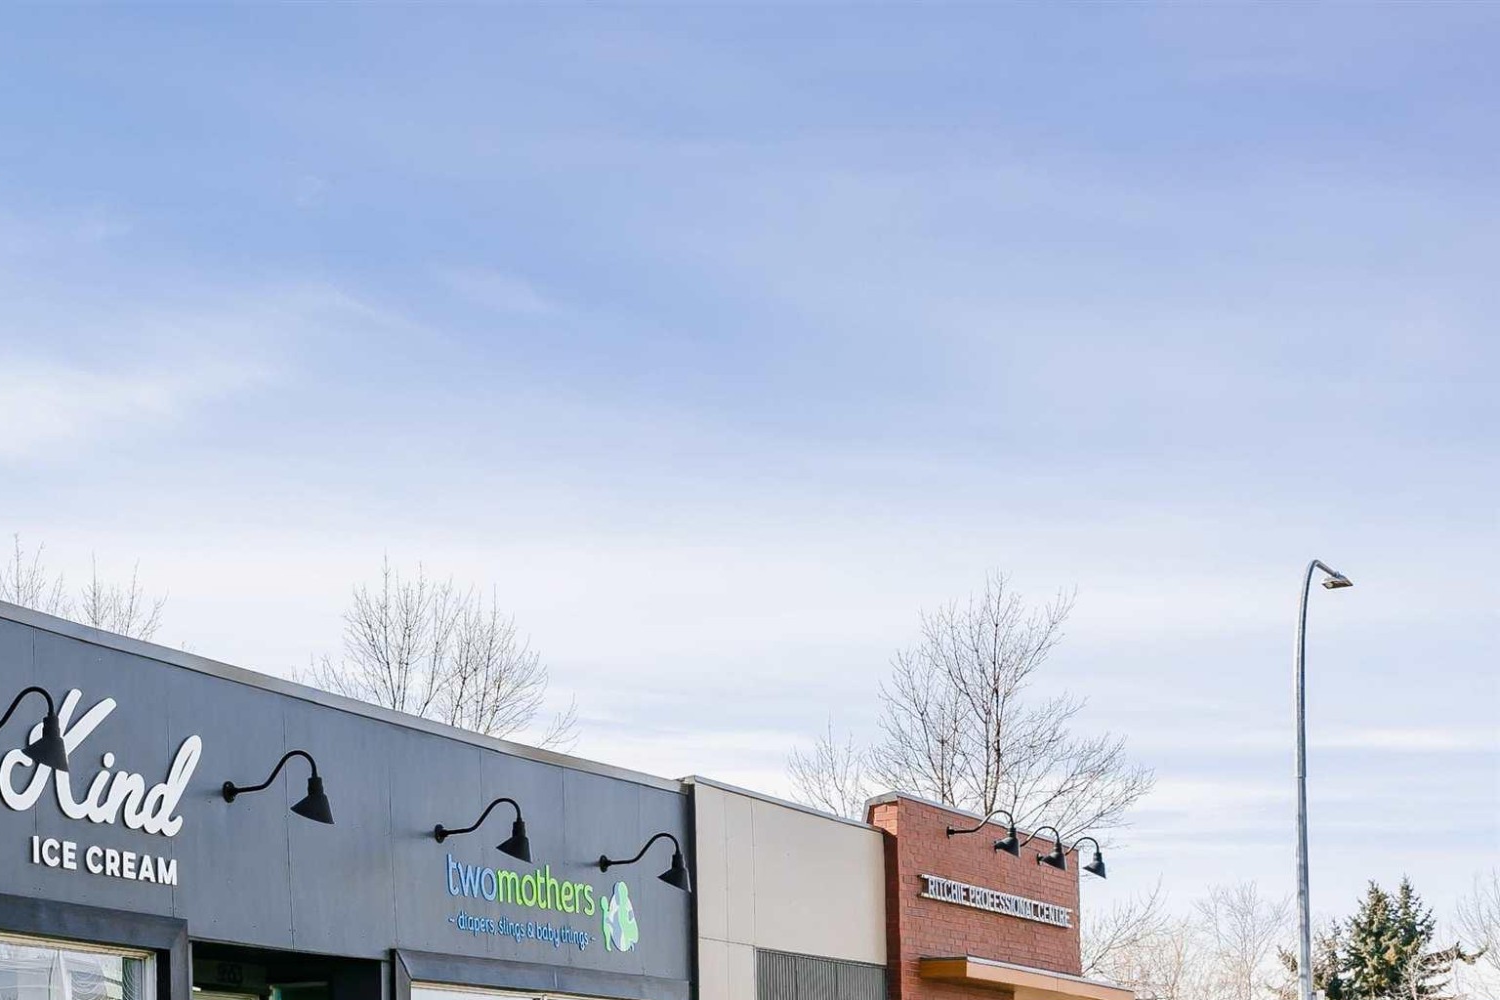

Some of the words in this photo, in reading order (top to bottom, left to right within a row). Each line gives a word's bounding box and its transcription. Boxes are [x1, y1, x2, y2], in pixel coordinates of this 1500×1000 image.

[0, 688, 202, 837] Kind
[31, 835, 77, 869] ICE
[85, 846, 178, 885] CREAM
[928, 878, 969, 904] RITCHIE
[969, 886, 1037, 919] PROFESSIONAL
[1038, 901, 1071, 925] CENTRE
[498, 916, 525, 942] slings
[527, 924, 535, 937] &
[535, 921, 560, 948] baby
[560, 926, 589, 951] things
